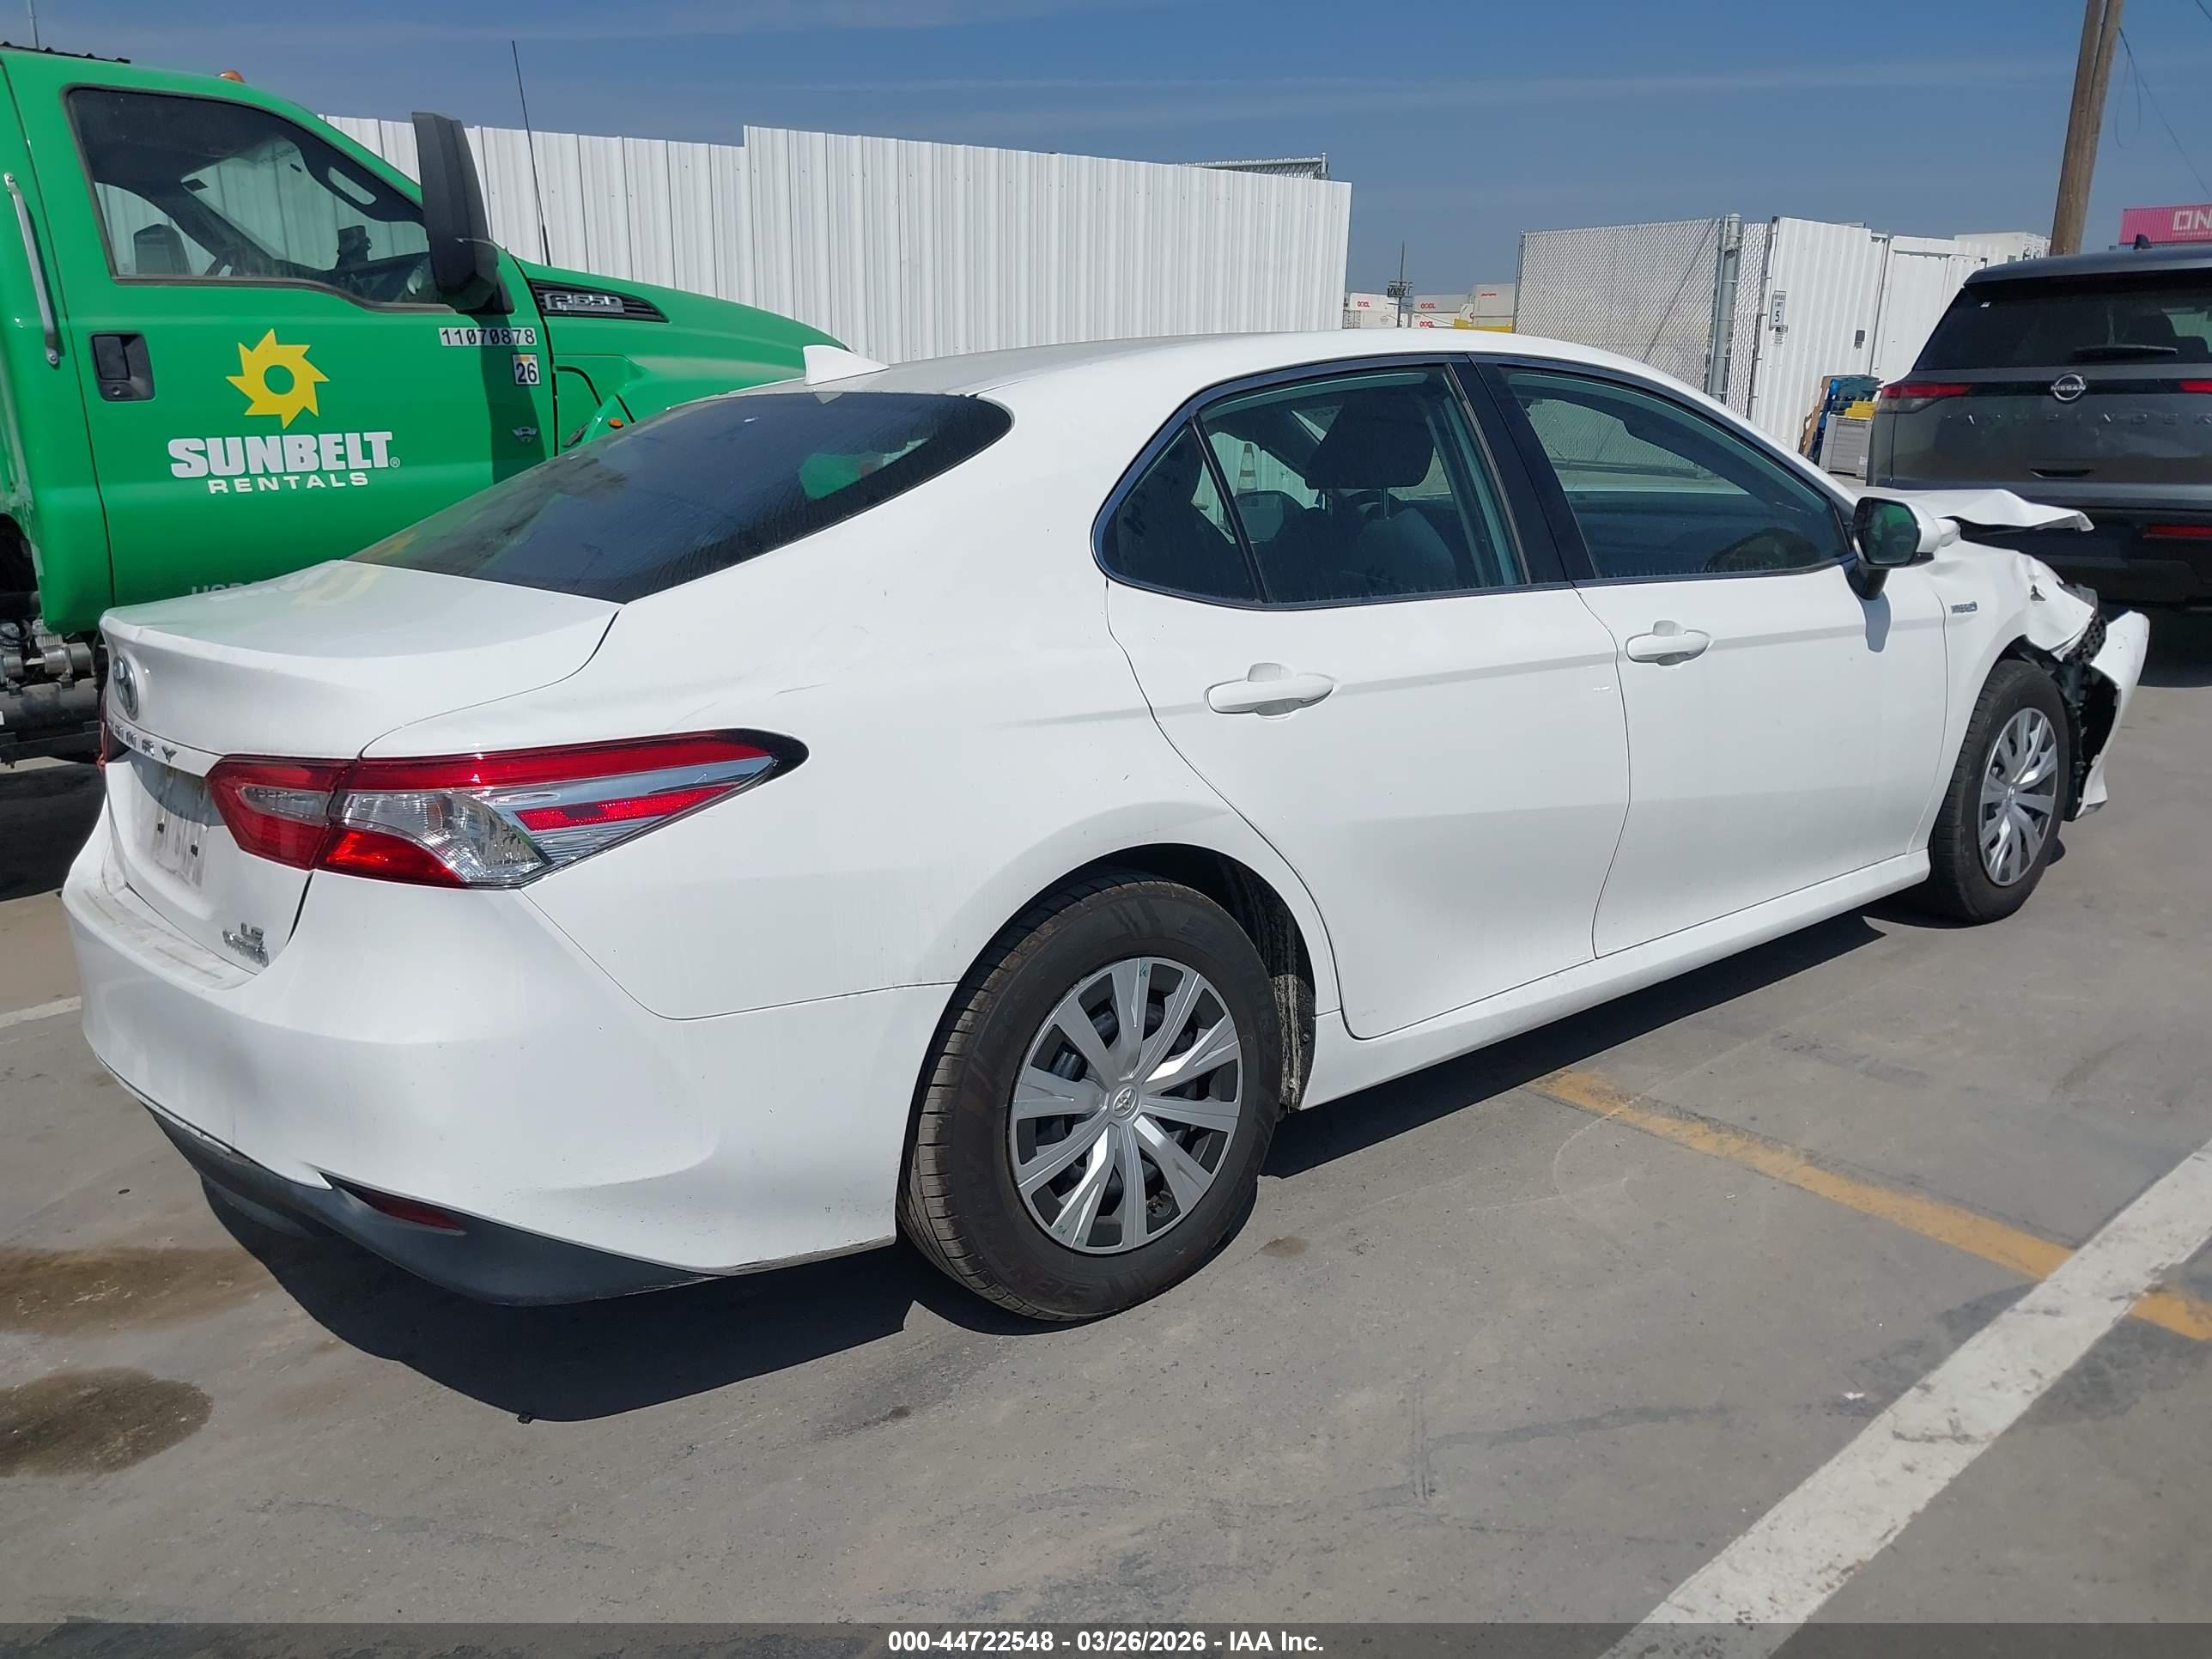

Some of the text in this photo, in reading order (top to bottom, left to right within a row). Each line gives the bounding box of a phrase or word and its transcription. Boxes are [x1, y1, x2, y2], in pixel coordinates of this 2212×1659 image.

[1774, 310, 1780, 323] 5
[441, 328, 537, 345] 11070878
[515, 362, 538, 383] 26
[207, 471, 368, 495] RENTALS
